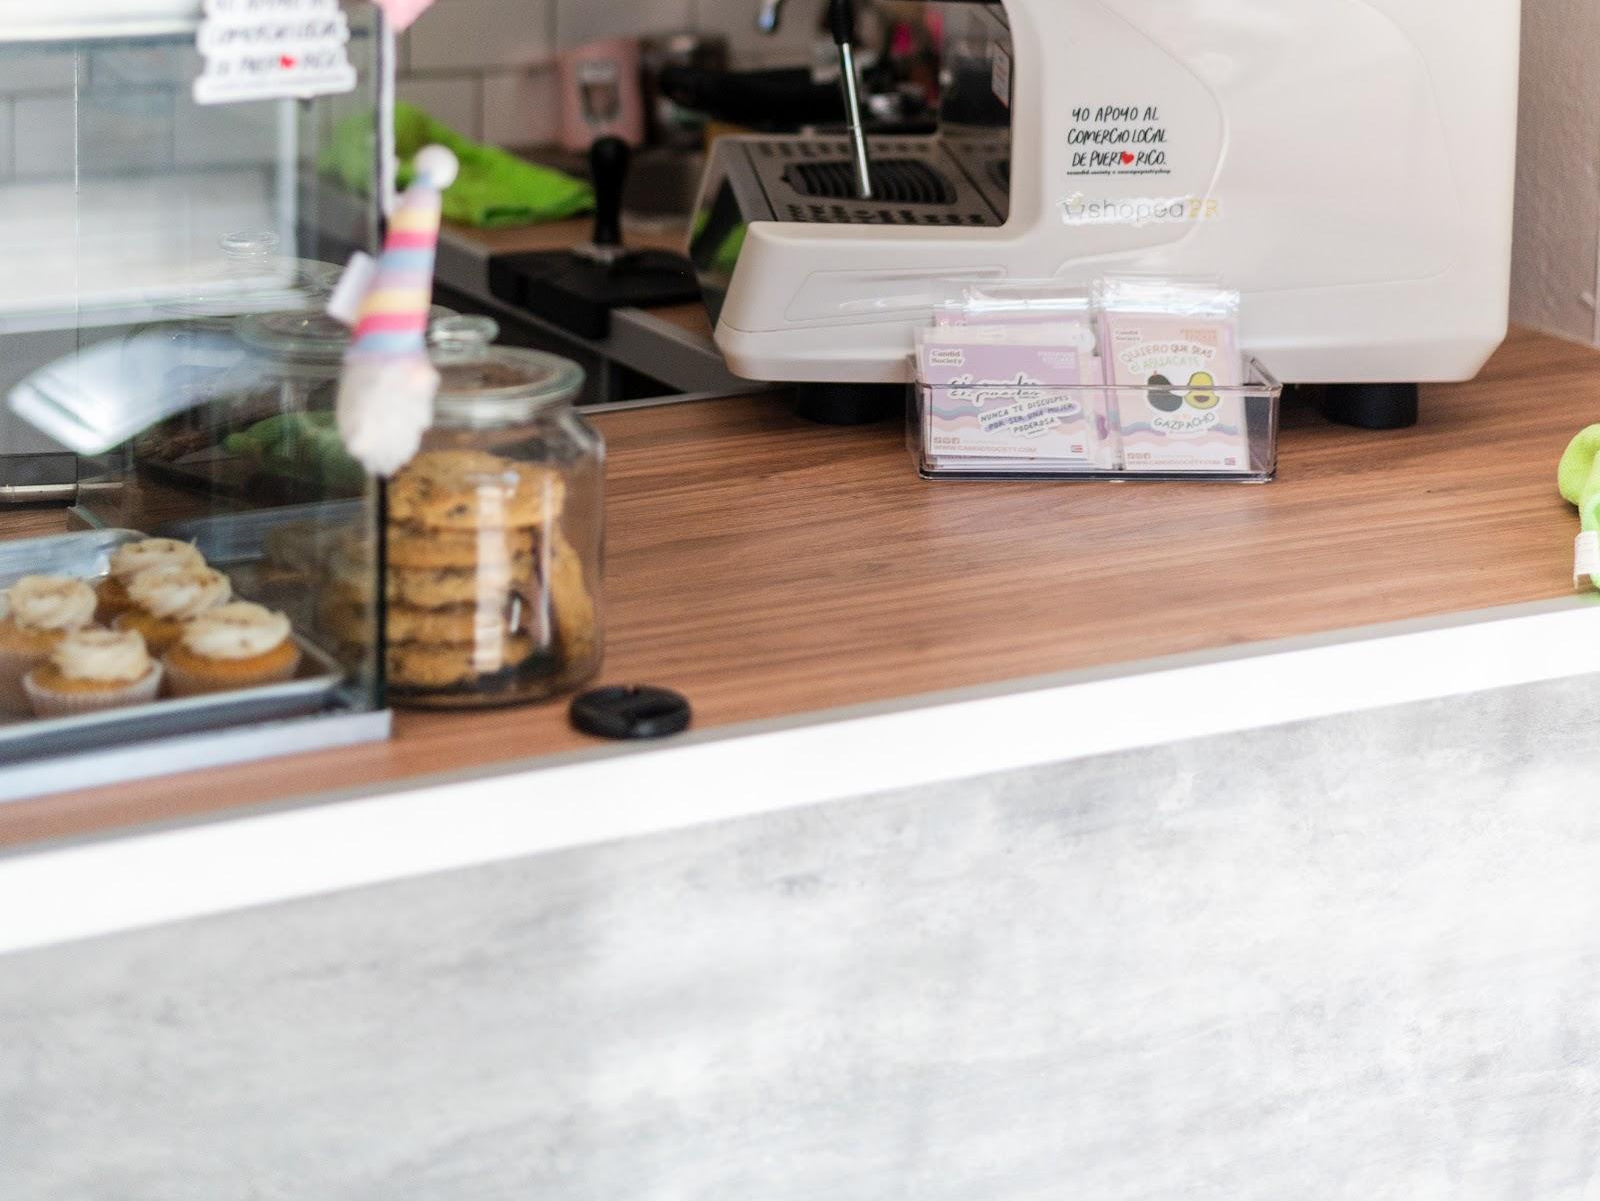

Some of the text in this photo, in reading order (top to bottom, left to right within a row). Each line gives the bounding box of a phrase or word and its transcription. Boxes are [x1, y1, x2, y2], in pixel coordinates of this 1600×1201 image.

[1072, 106, 1159, 122] YO APOYO AL
[1067, 127, 1167, 144] COMERCIO LOCAL
[1072, 152, 1087, 167] DE
[1121, 344, 1168, 362] QUIERO
[1171, 343, 1187, 353] QUE
[980, 395, 1069, 422] NUNCA TE DISCULPES
[988, 420, 1005, 430] POR
[1009, 416, 1024, 426] SER
[1027, 411, 1044, 420] UNA
[1013, 417, 1055, 432] PODEROSA
[1153, 412, 1215, 430] GAZPACHO
